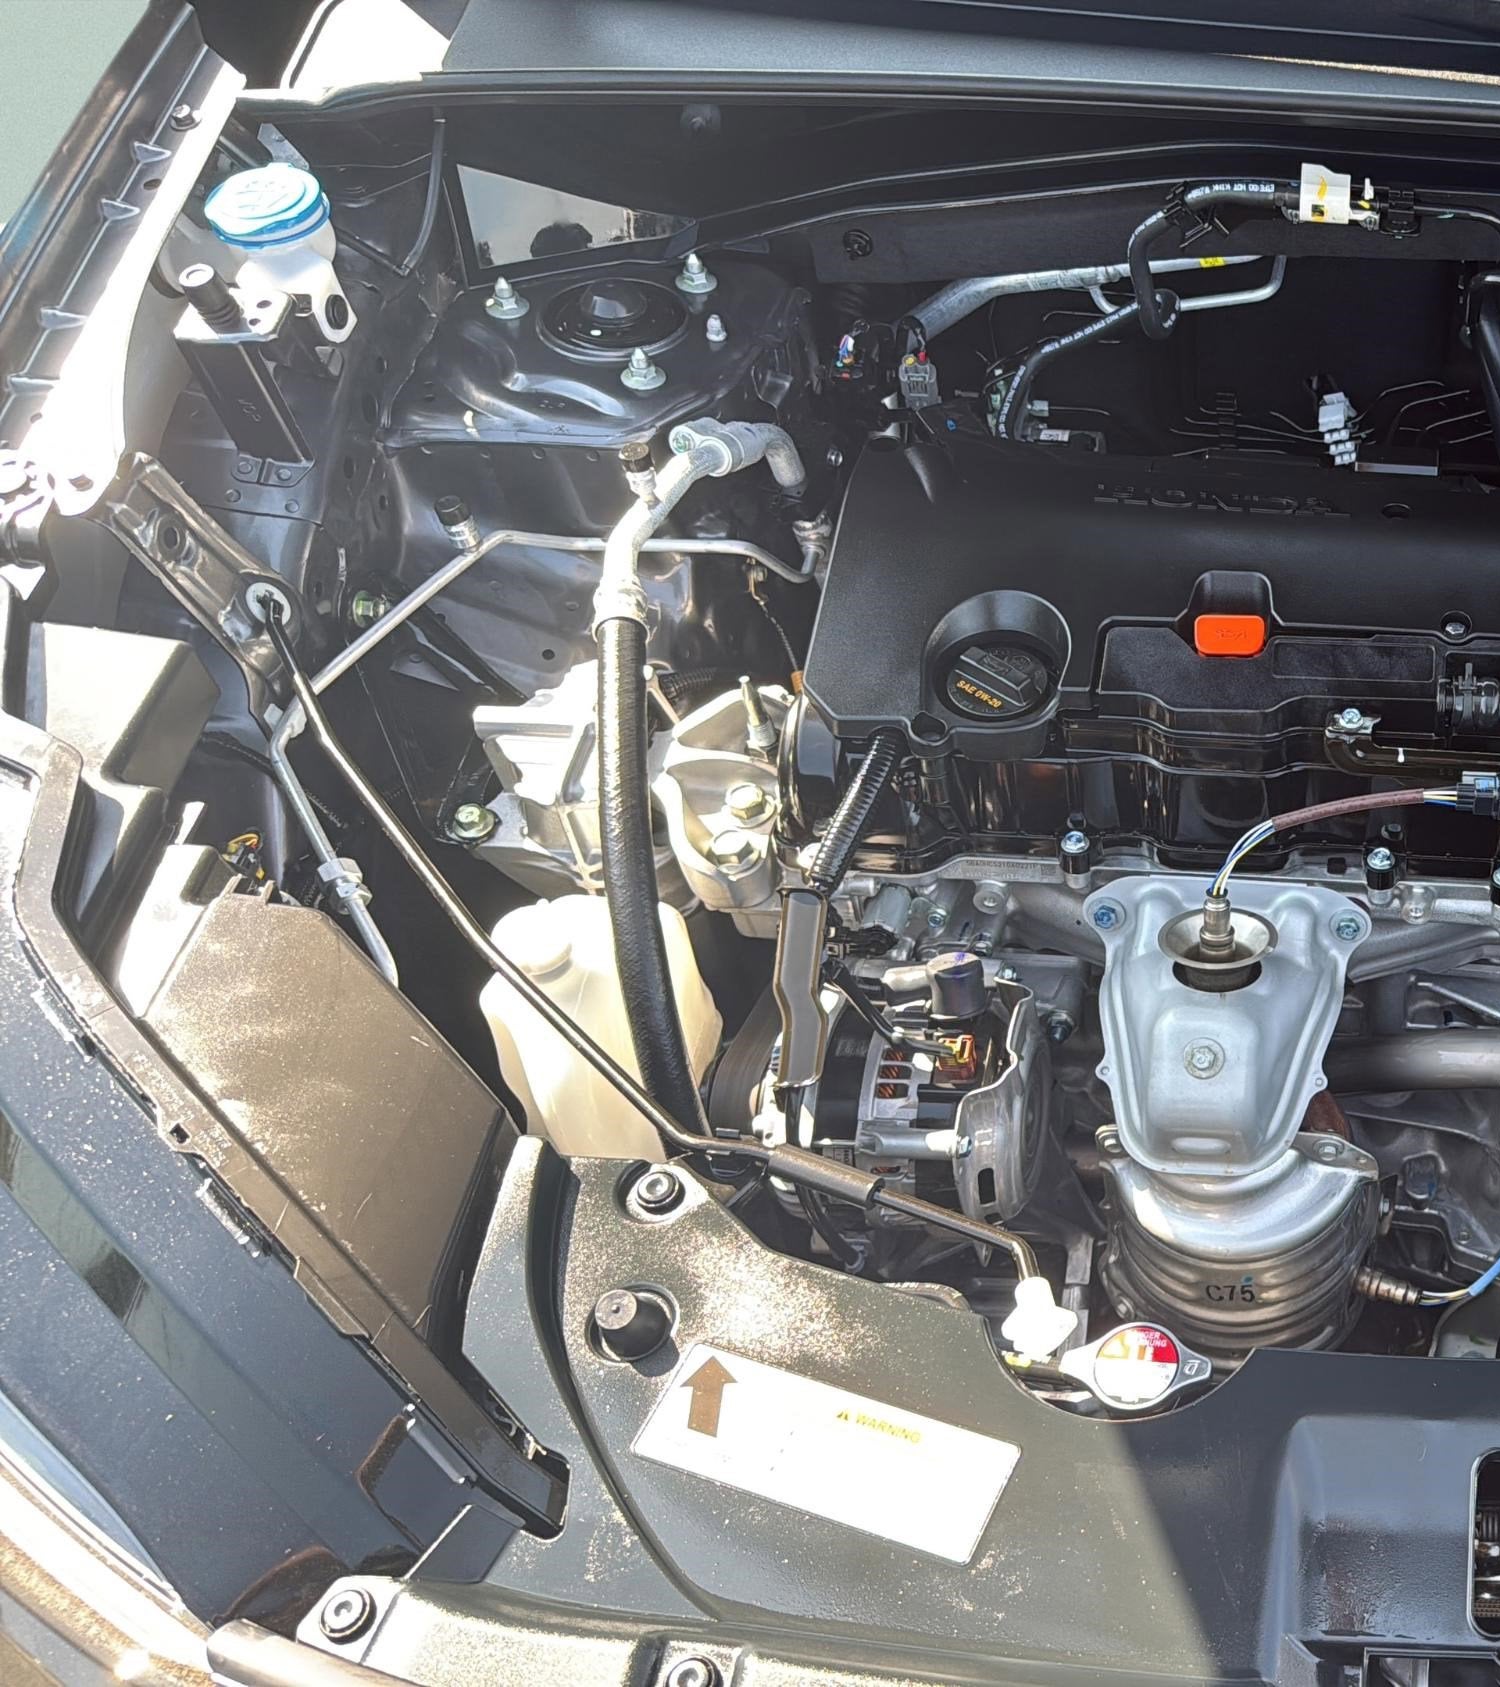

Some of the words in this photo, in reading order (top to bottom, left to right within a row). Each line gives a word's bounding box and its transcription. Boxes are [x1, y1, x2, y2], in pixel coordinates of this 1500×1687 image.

[1094, 483, 1351, 517] HONDA
[956, 680, 977, 694] SAE
[974, 690, 1002, 708] 0W-20
[1205, 1285, 1256, 1302] C75
[855, 1413, 921, 1443] WARNING
